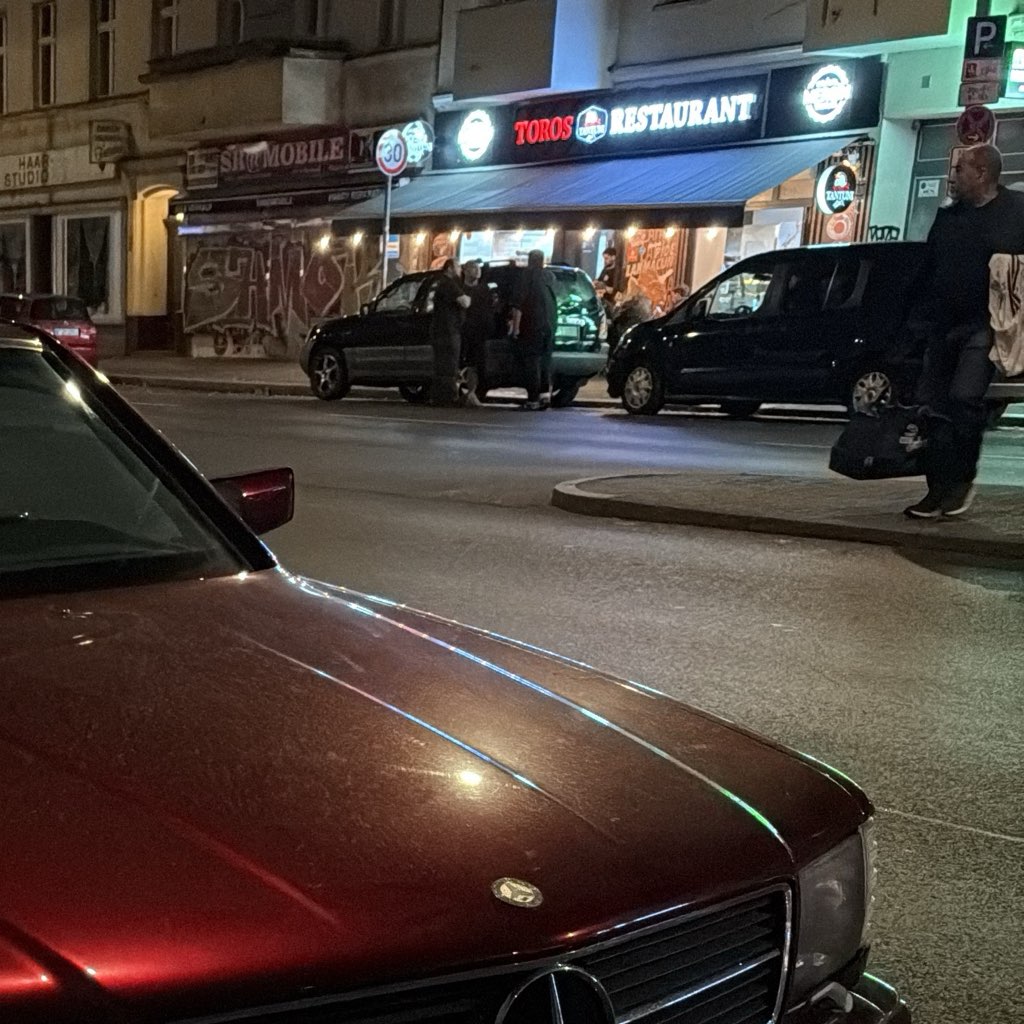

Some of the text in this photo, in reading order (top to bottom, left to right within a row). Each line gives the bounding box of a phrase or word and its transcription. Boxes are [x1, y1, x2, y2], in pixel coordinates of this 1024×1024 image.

[974, 21, 997, 55] P
[514, 115, 574, 145] TOROS
[609, 93, 757, 135] RESTAURANT
[19, 153, 49, 170] HAAR
[384, 143, 402, 163] 30
[4, 168, 50, 187] STUDIO
